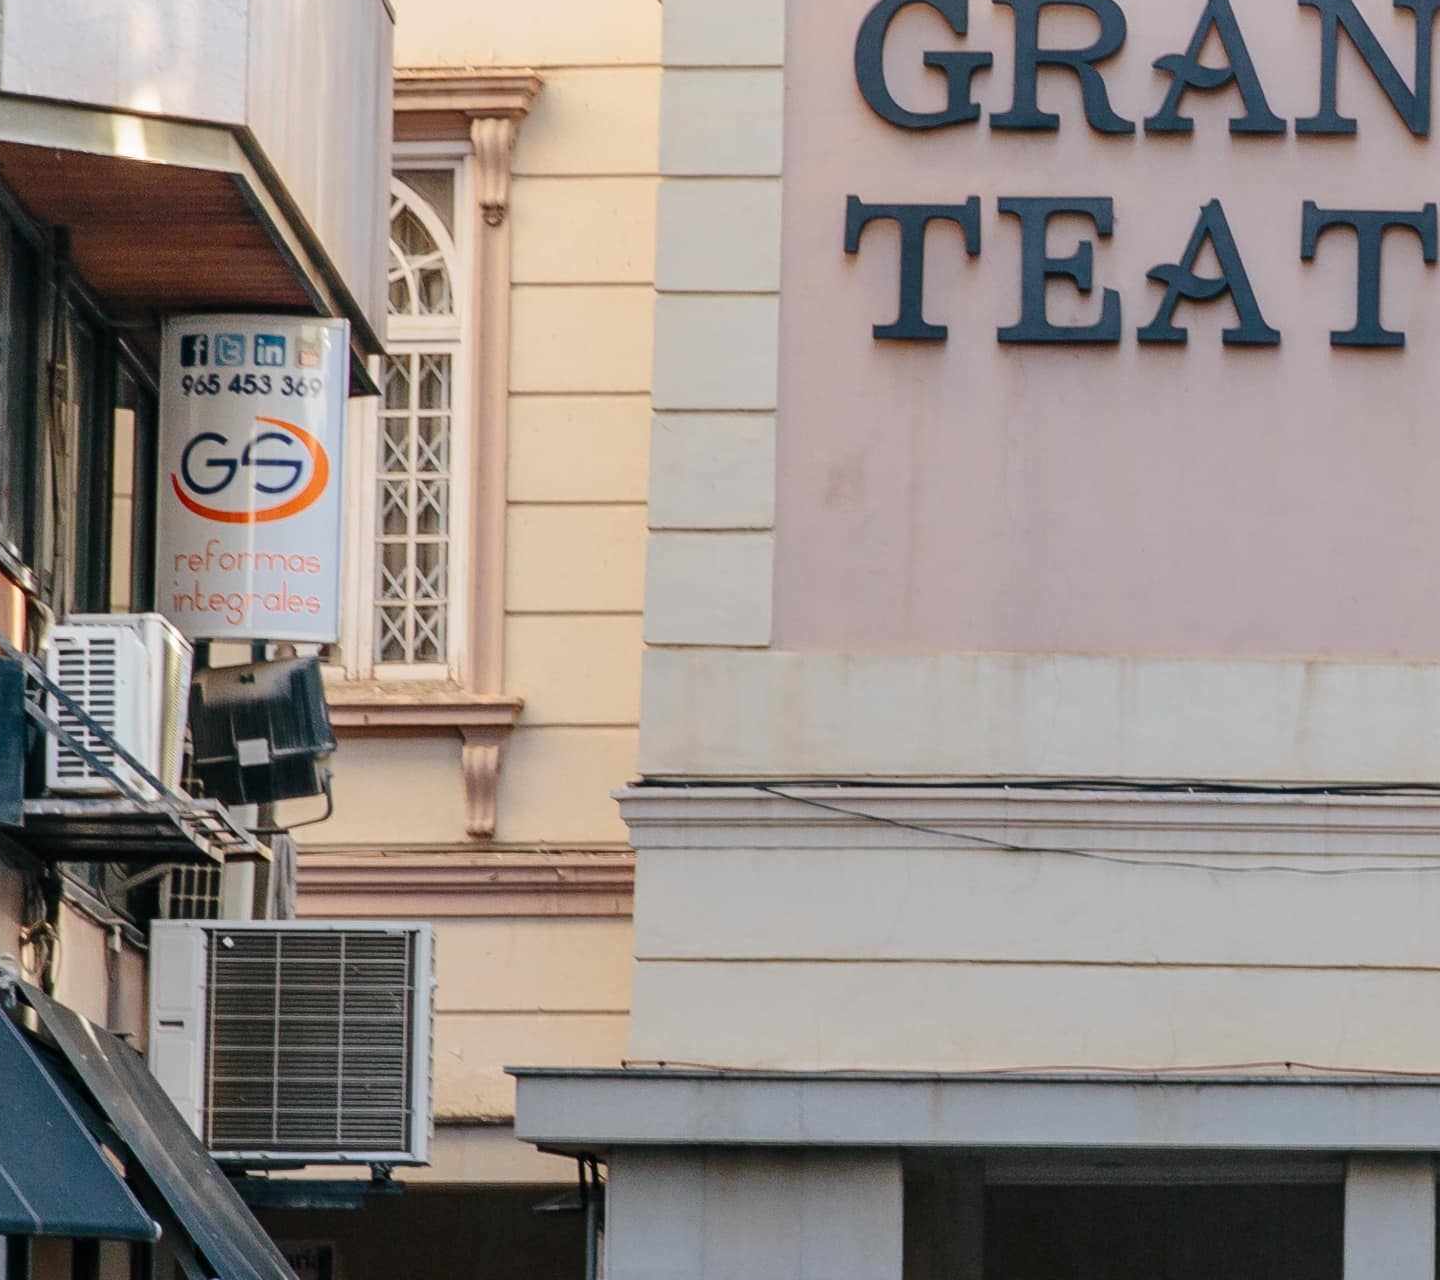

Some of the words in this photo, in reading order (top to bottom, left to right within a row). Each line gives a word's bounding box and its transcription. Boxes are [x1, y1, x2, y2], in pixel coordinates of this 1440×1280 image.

[181, 374, 221, 396] 965
[228, 374, 273, 396] 453
[281, 375, 323, 396] 369
[181, 431, 303, 496] GS
[174, 539, 321, 574] reformas
[173, 581, 321, 625] integrales
